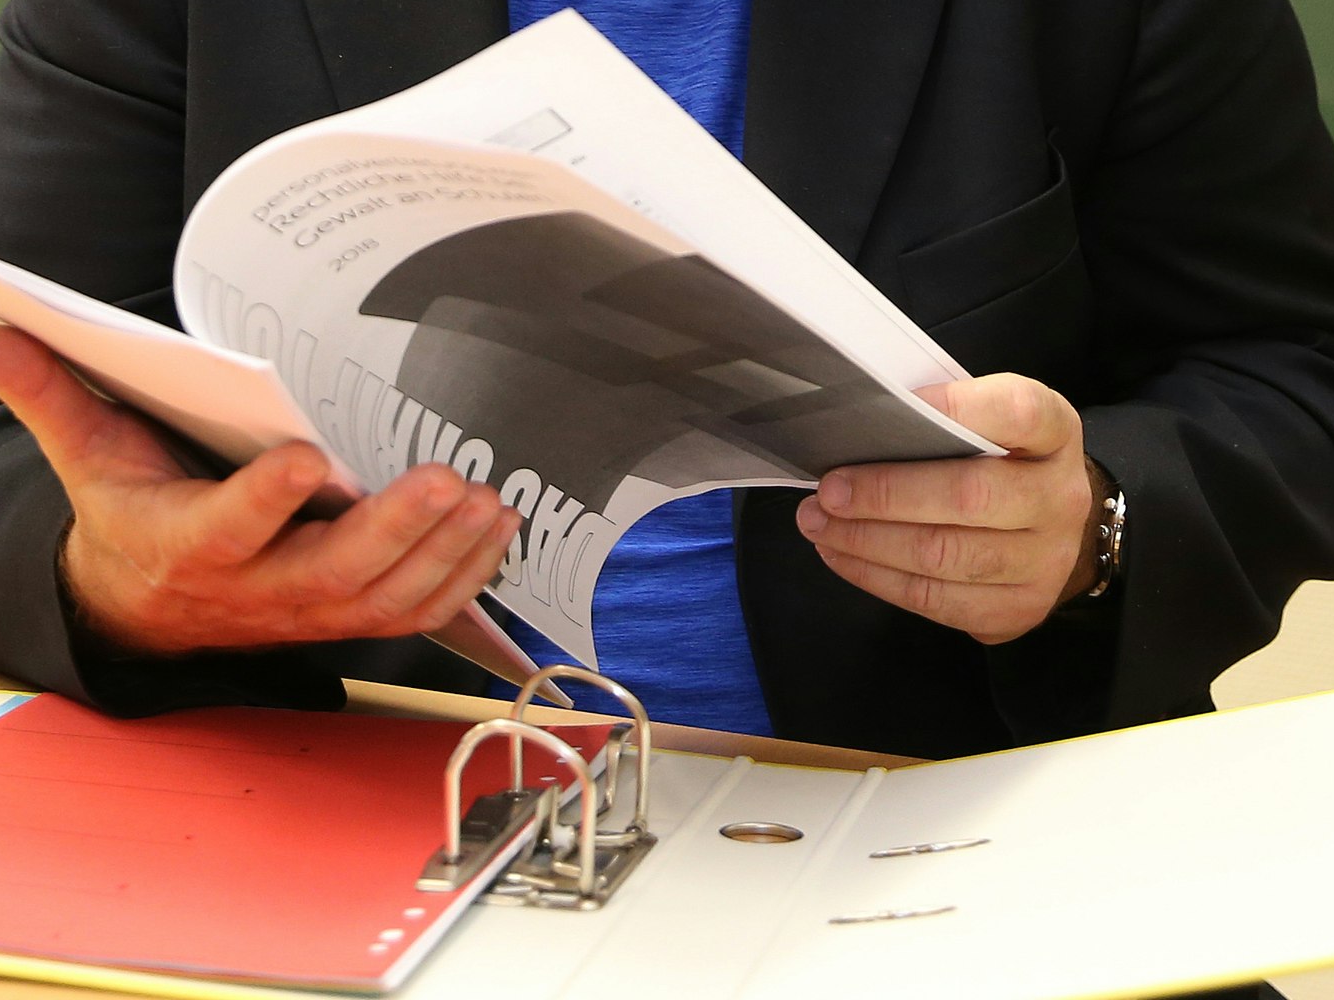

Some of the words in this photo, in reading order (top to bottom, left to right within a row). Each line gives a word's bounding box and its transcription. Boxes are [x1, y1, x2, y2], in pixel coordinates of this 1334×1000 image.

[269, 171, 415, 234] Rechtliche
[293, 196, 394, 248] Gewalt
[396, 188, 435, 204] an
[328, 237, 381, 273] 2018
